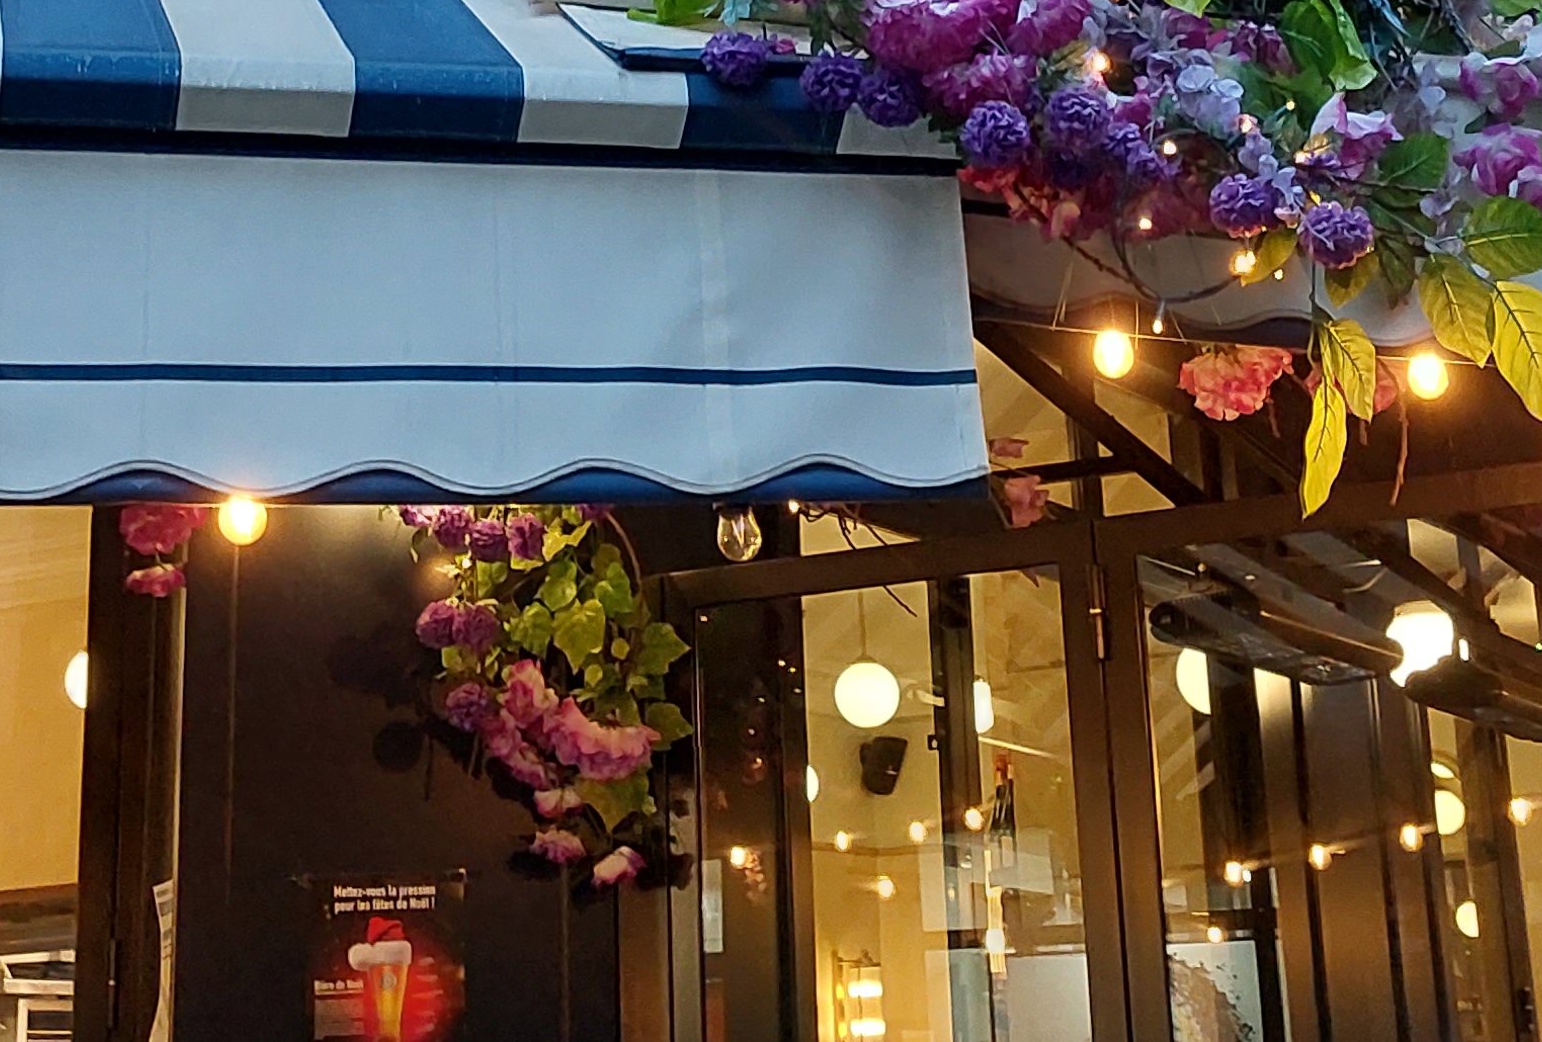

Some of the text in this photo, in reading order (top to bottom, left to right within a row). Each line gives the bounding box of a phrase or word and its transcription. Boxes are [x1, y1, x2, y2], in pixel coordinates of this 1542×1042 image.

[388, 884, 397, 897] la
[399, 884, 436, 900] pression
[334, 901, 355, 915] pour
[357, 899, 370, 911] les
[396, 899, 408, 910] de
